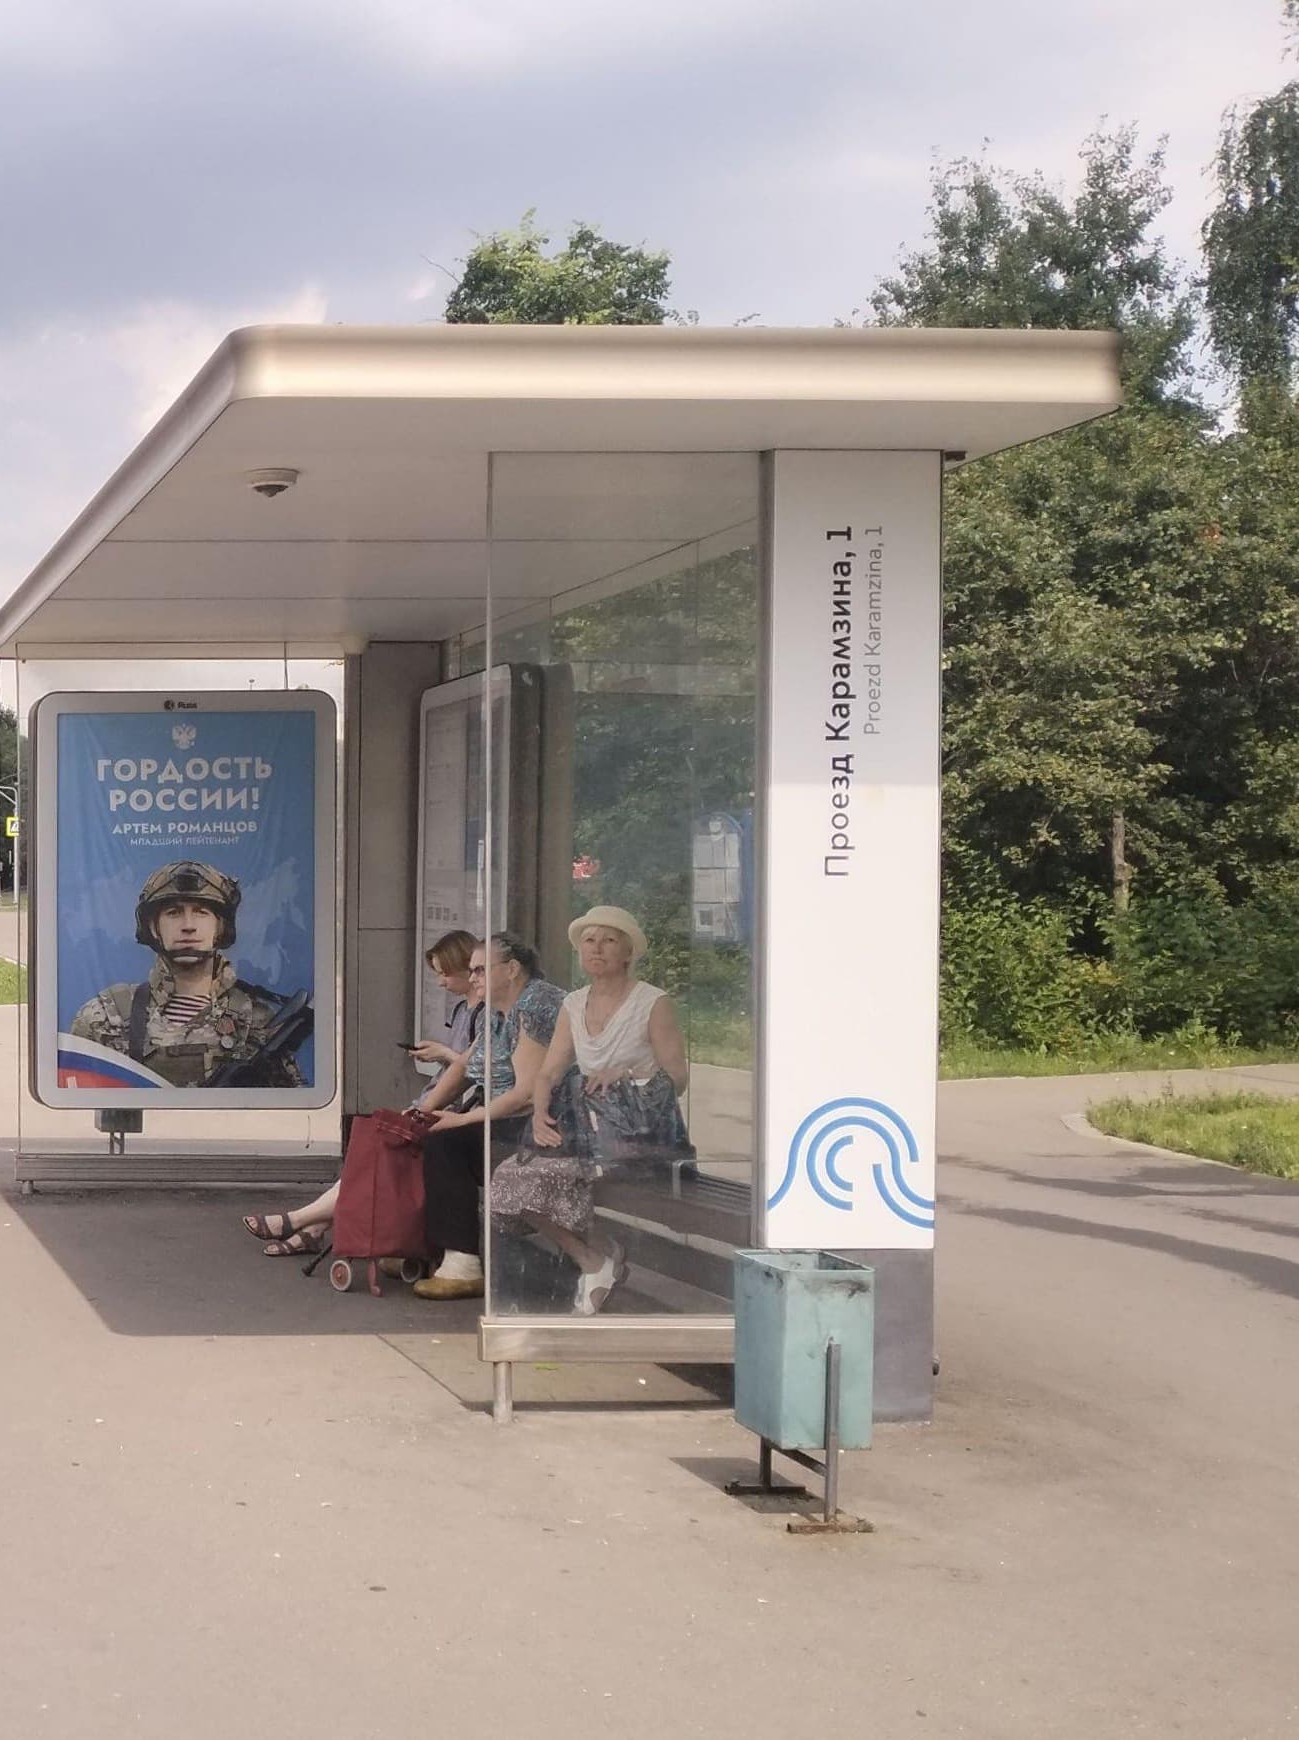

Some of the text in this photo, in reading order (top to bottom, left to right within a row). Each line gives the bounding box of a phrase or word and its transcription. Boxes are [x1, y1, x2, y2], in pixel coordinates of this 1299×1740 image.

[863, 525, 884, 735] Proezd Karamzina, 1
[824, 525, 857, 876] Проезд Карамзина, 1
[96, 757, 273, 784] ГОРДОСТЬ
[109, 787, 261, 812] РОССИИ!
[112, 820, 258, 835] АРТЕМ РОМАНЦОВ
[130, 835, 240, 847] МЛАДШИЙ ЛЕЙТЕНАНТ
